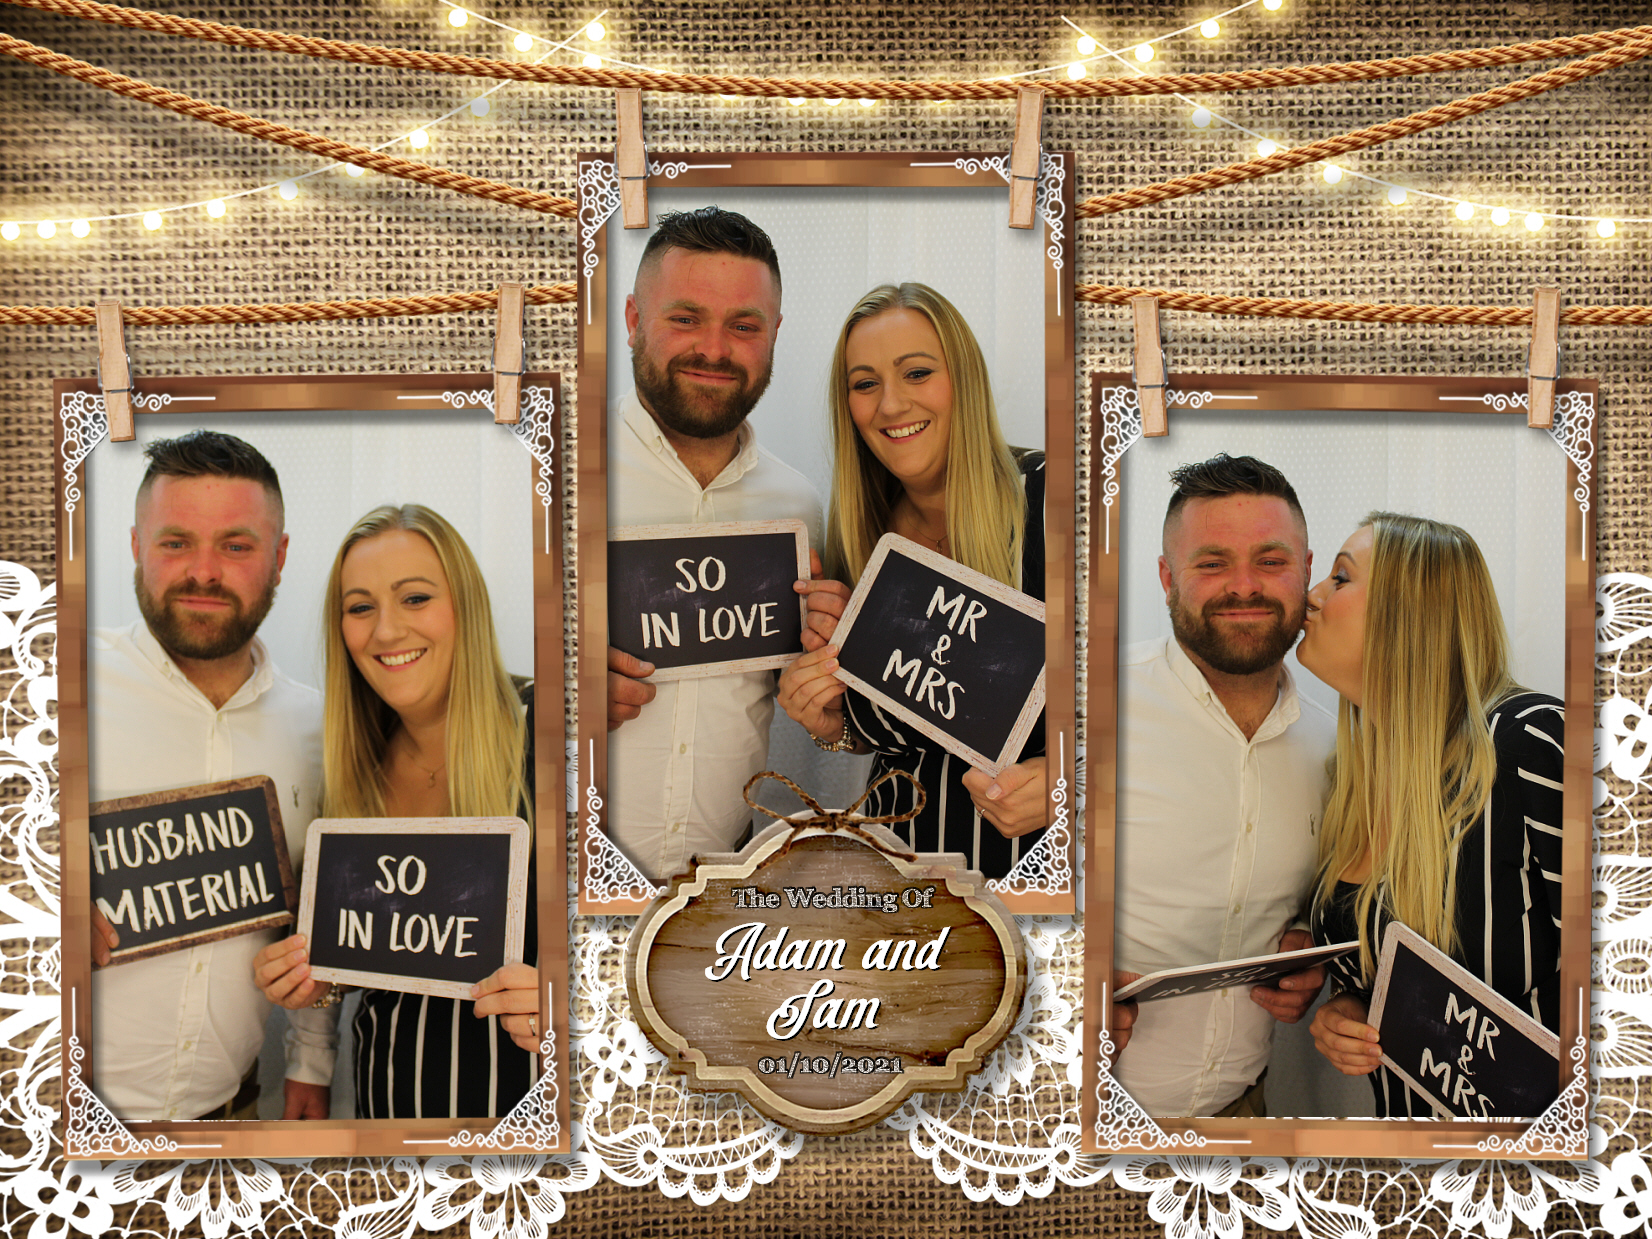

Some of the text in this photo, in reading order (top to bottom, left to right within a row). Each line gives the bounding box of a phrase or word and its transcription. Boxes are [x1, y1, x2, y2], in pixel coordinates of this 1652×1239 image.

[674, 556, 727, 594] SO
[640, 602, 780, 649] IN LOVE
[925, 585, 988, 643] MR
[930, 634, 951, 666] &
[881, 648, 966, 721] MRS
[90, 807, 254, 875] HUSBAND
[95, 861, 275, 933] MATERIAL
[374, 854, 427, 895] SO
[338, 908, 479, 958] IN LOVE
[1150, 985, 1196, 999] IN
[1444, 992, 1500, 1061] MR
[1419, 1047, 1496, 1117] MRS
[1457, 1044, 1477, 1075] &
